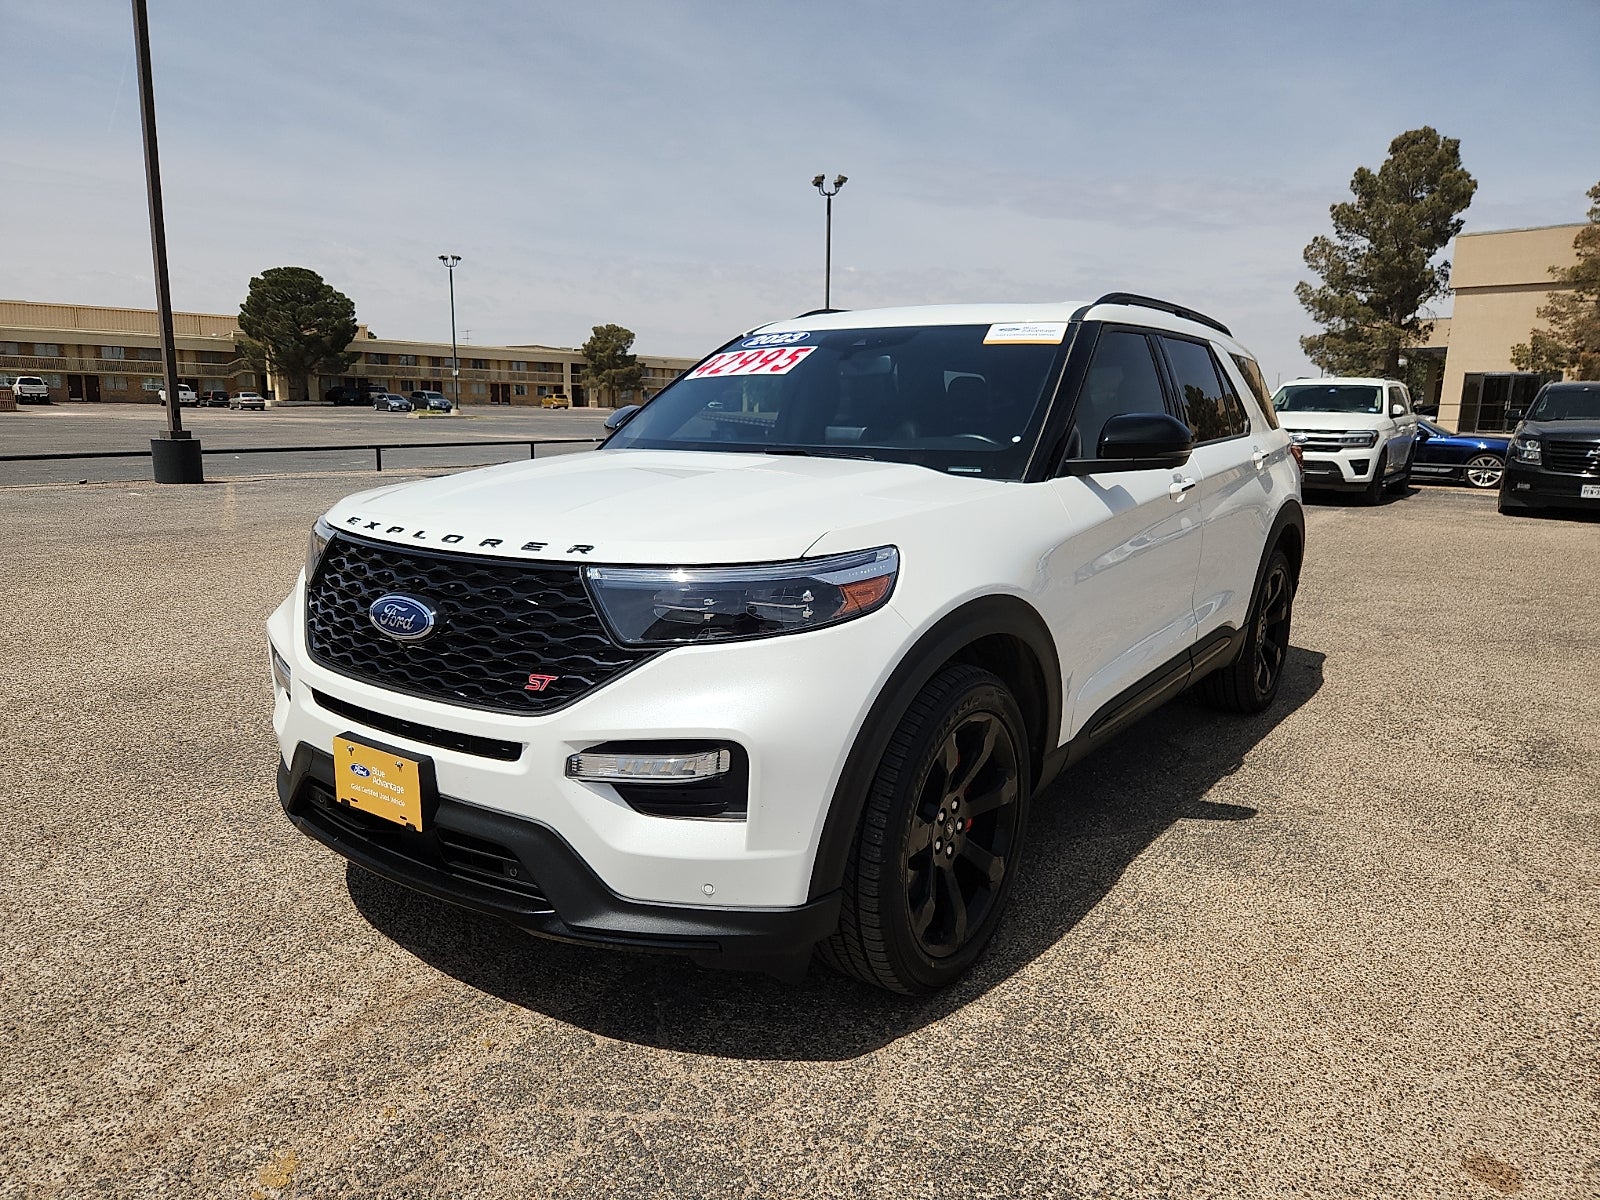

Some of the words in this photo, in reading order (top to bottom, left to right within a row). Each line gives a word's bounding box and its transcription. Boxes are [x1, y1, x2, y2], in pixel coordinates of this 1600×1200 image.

[751, 332, 801, 345] 2023
[696, 348, 813, 376] 42995
[346, 516, 595, 555] EXPLORER
[379, 603, 414, 630] Ford
[524, 674, 558, 691] ST
[372, 766, 385, 777] Blue
[373, 776, 404, 793] Advantage
